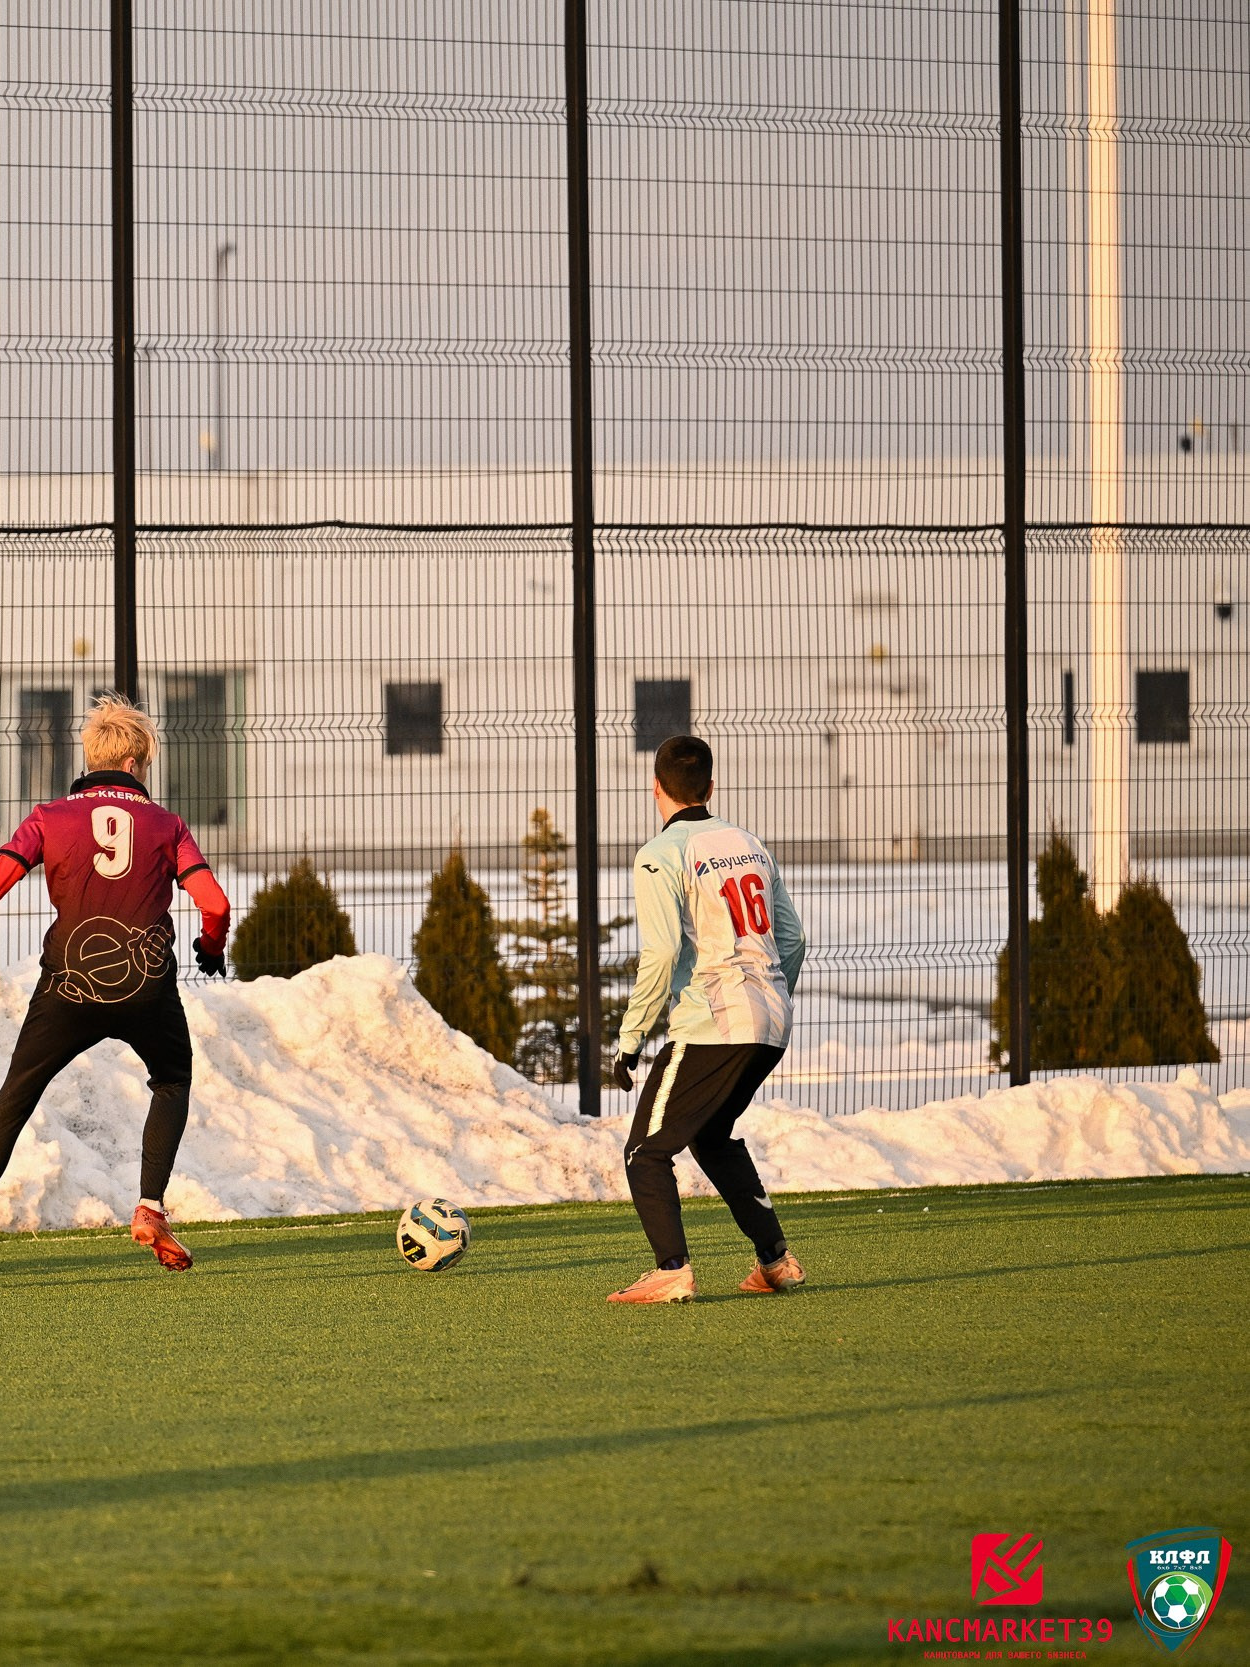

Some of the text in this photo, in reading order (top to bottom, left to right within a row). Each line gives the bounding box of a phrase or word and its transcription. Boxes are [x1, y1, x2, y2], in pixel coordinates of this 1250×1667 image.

[90, 805, 134, 880] 9
[708, 852, 767, 871] Бауцентр
[718, 873, 771, 938] 16
